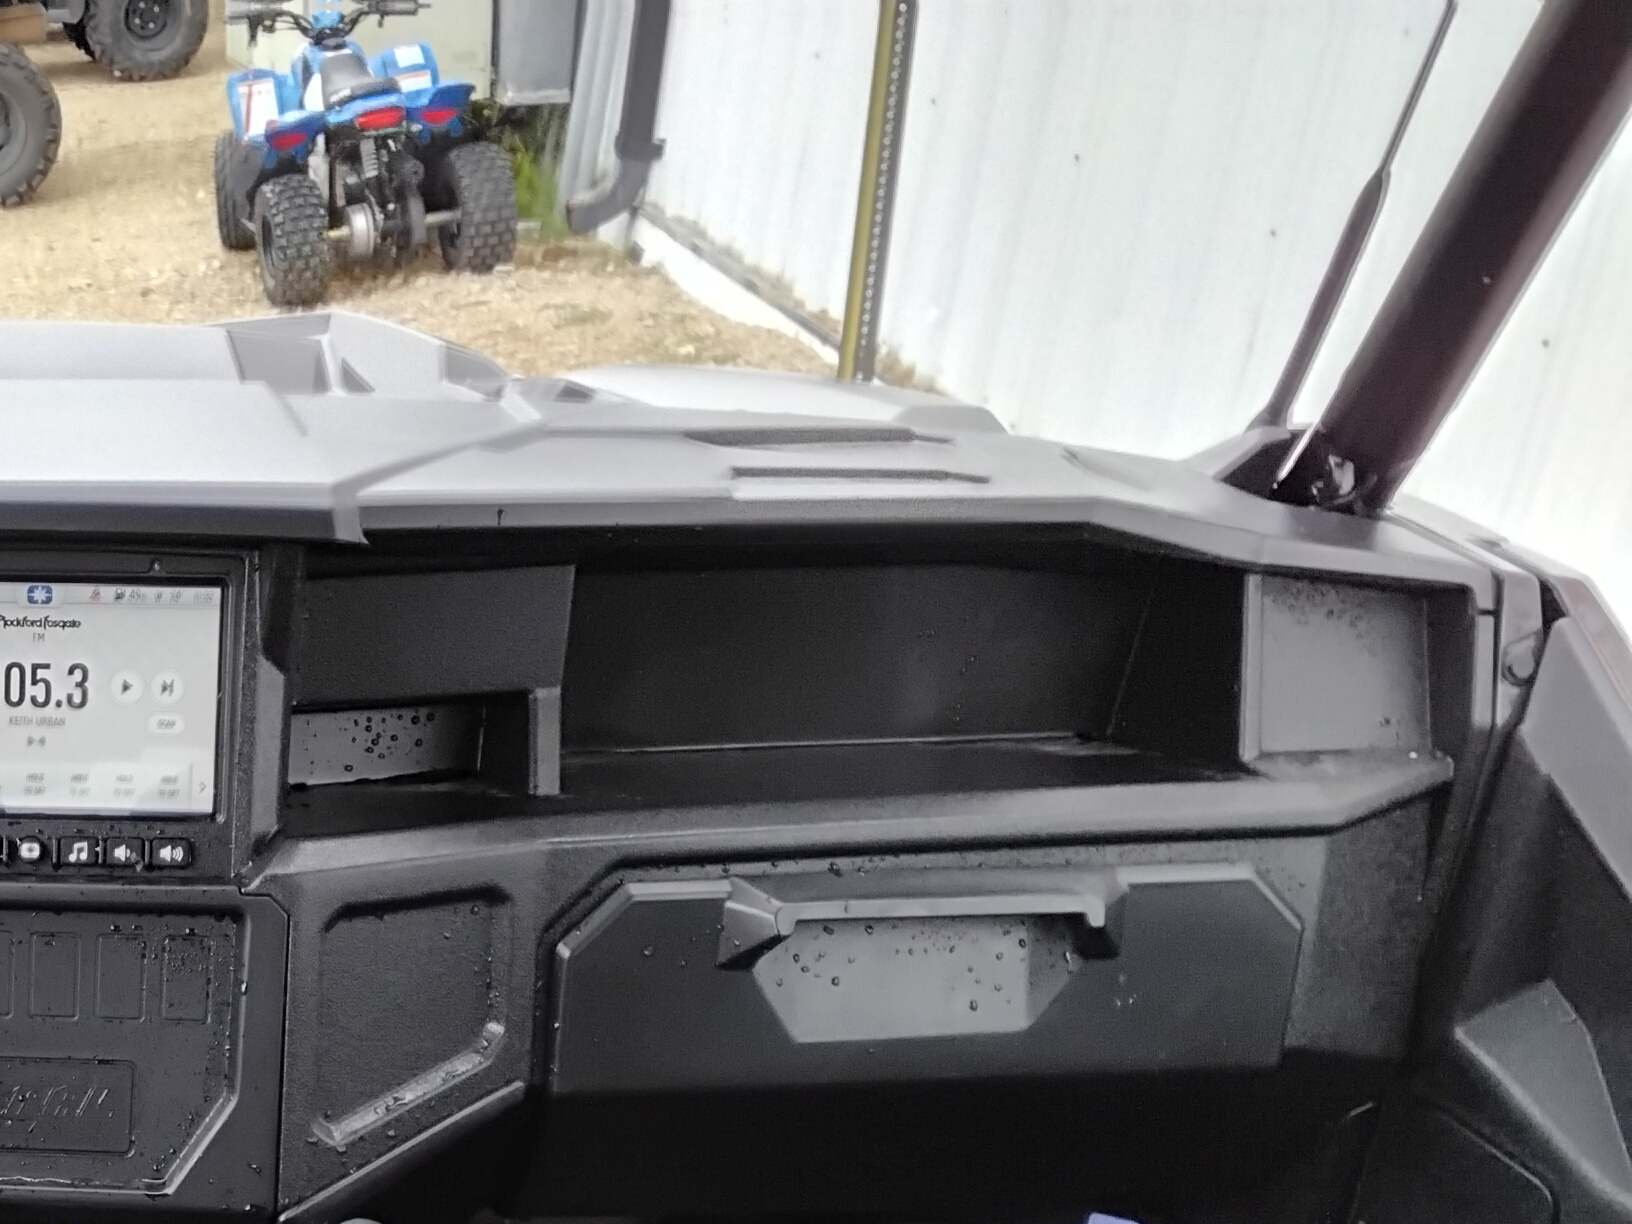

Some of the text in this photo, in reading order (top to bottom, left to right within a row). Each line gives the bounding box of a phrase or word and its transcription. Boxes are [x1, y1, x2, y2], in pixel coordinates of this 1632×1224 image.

[32, 633, 45, 642] FM
[9, 716, 66, 727] KEITH URBAN
